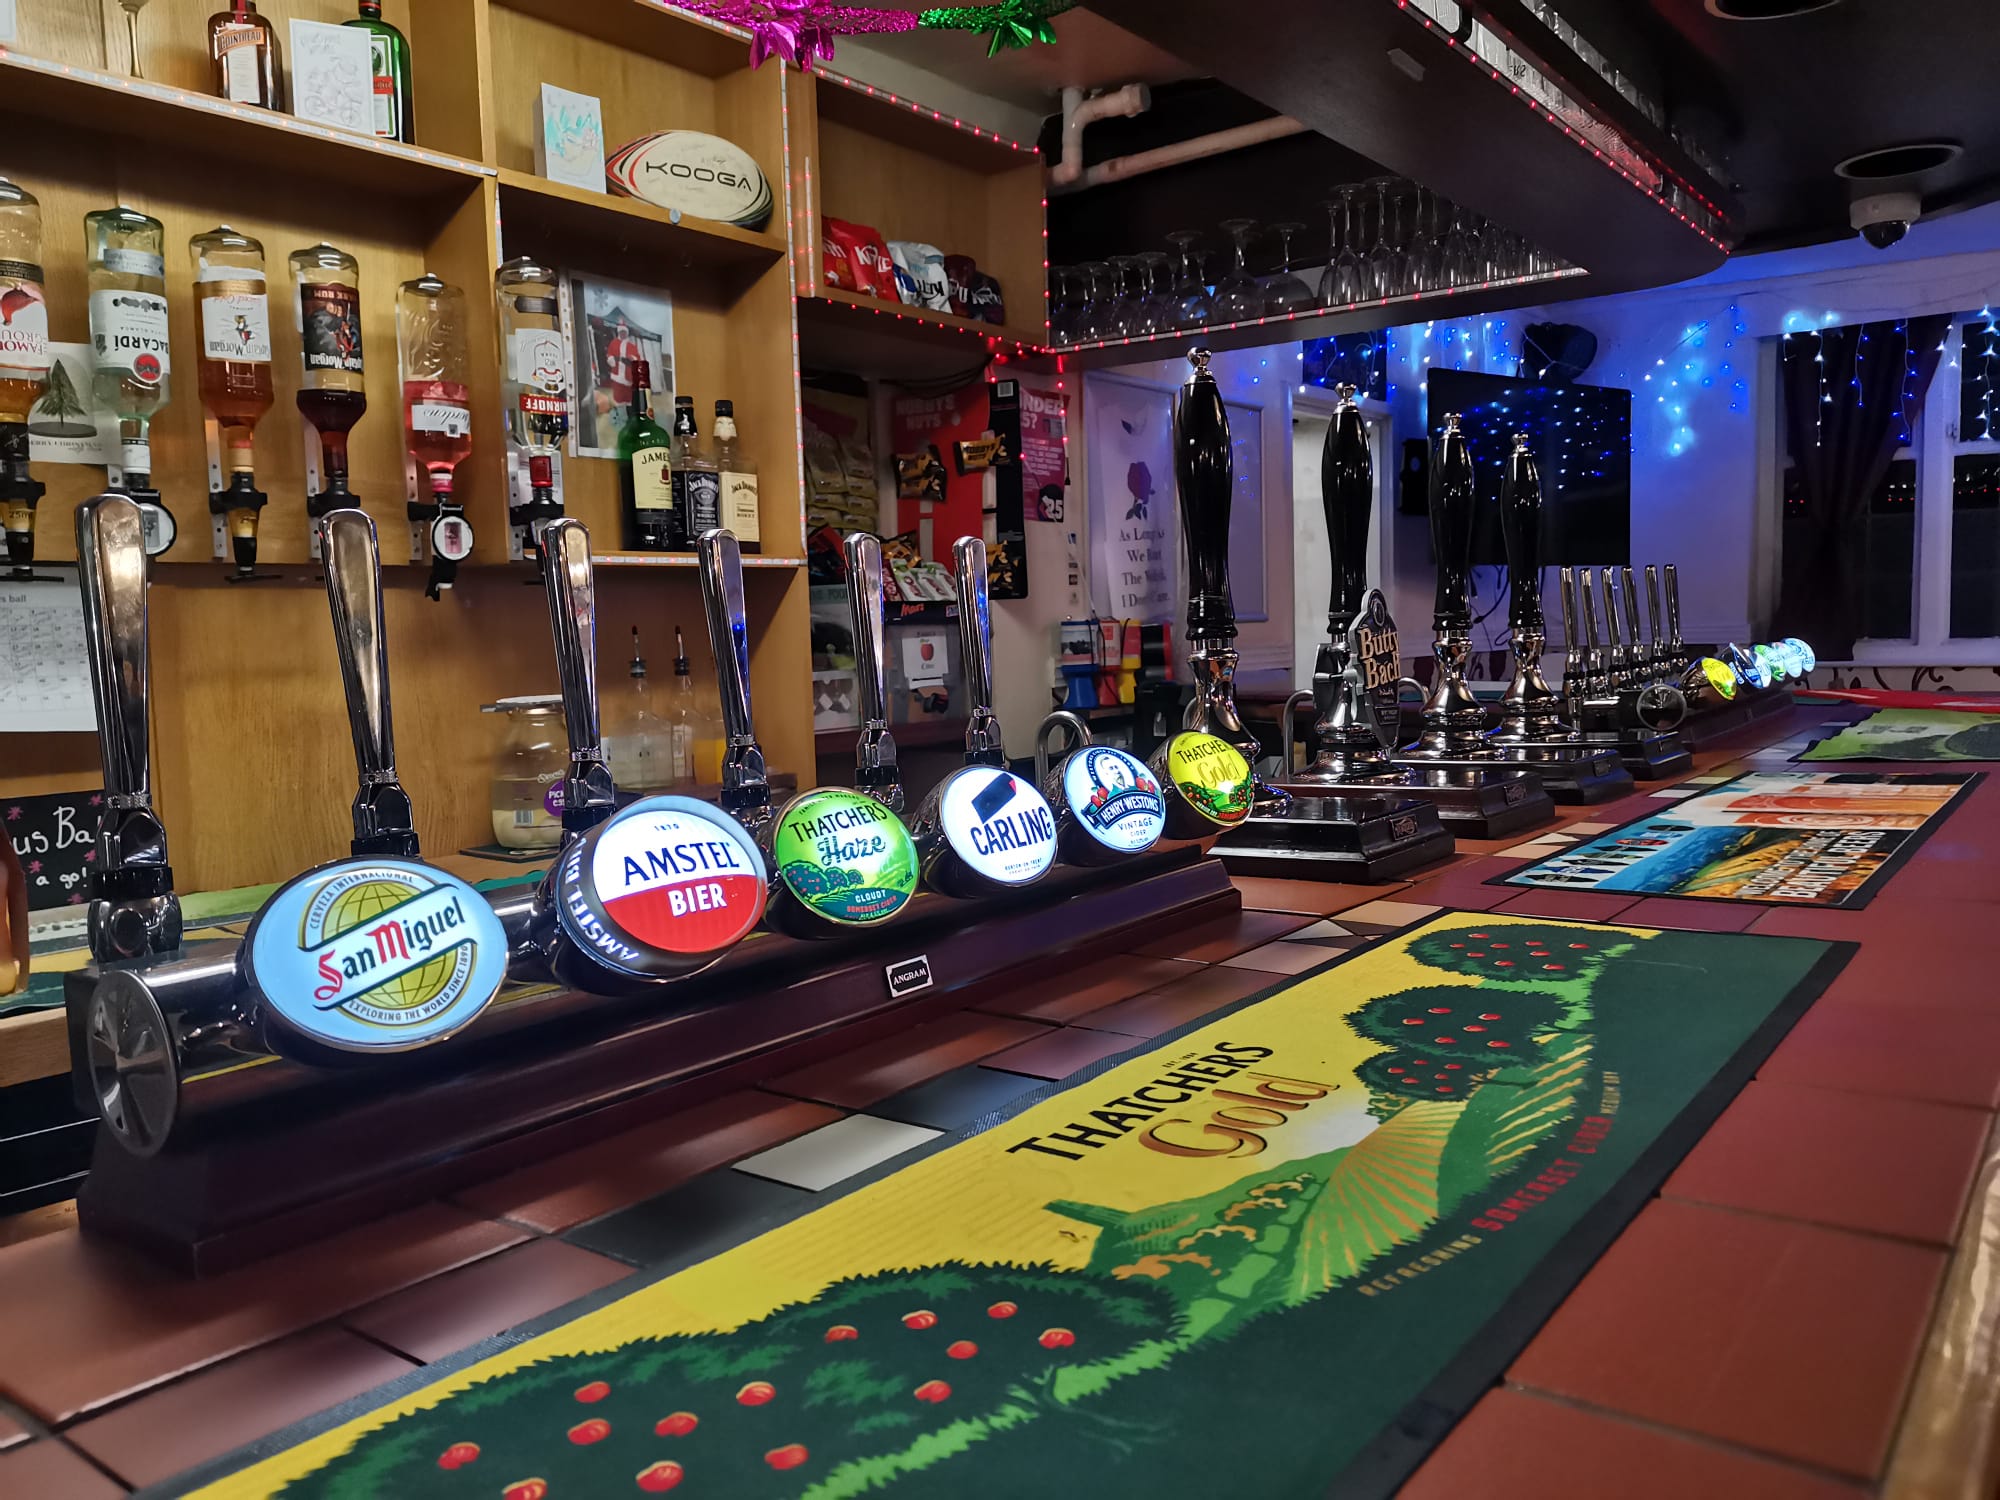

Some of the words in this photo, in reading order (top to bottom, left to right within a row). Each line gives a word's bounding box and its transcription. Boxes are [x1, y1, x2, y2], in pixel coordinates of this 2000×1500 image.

[646, 161, 752, 192] KOOGA
[209, 340, 243, 358] Morgan
[310, 353, 344, 374] Morgan
[1126, 549, 1145, 562] We
[1121, 571, 1142, 586] The
[1357, 627, 1400, 660] Butty
[1197, 753, 1242, 788] Gold
[788, 802, 888, 843] THATCHERS
[1100, 798, 1125, 823] HENRY
[1125, 795, 1159, 812] WESTONS
[1117, 816, 1153, 831] VINTAGE
[13, 829, 49, 855] us
[969, 806, 1053, 856] CARLING
[624, 842, 741, 887] AMSTEL
[817, 835, 886, 867] Haze
[1769, 854, 1862, 898] BEAUTIFUL
[1826, 831, 1887, 853] BEERS
[36, 873, 49, 886] a
[59, 867, 88, 889] go!
[310, 889, 336, 931] CERVEZA
[335, 871, 414, 893] INTERNACIONAL
[667, 883, 728, 918] BIER
[855, 889, 887, 904] CLOUDY
[313, 949, 377, 1002] San
[364, 895, 466, 965] Miguel
[349, 999, 402, 1022] EXPLORING
[404, 1010, 421, 1022] THE
[422, 991, 451, 1016] WORLD
[449, 967, 466, 992] SINCE
[458, 944, 470, 968] 1890
[893, 967, 927, 986] ANGRAM
[1005, 1041, 1274, 1161] THATCHERS
[1138, 1071, 1341, 1158] Gold
[1471, 1158, 1583, 1232] SOMERSET
